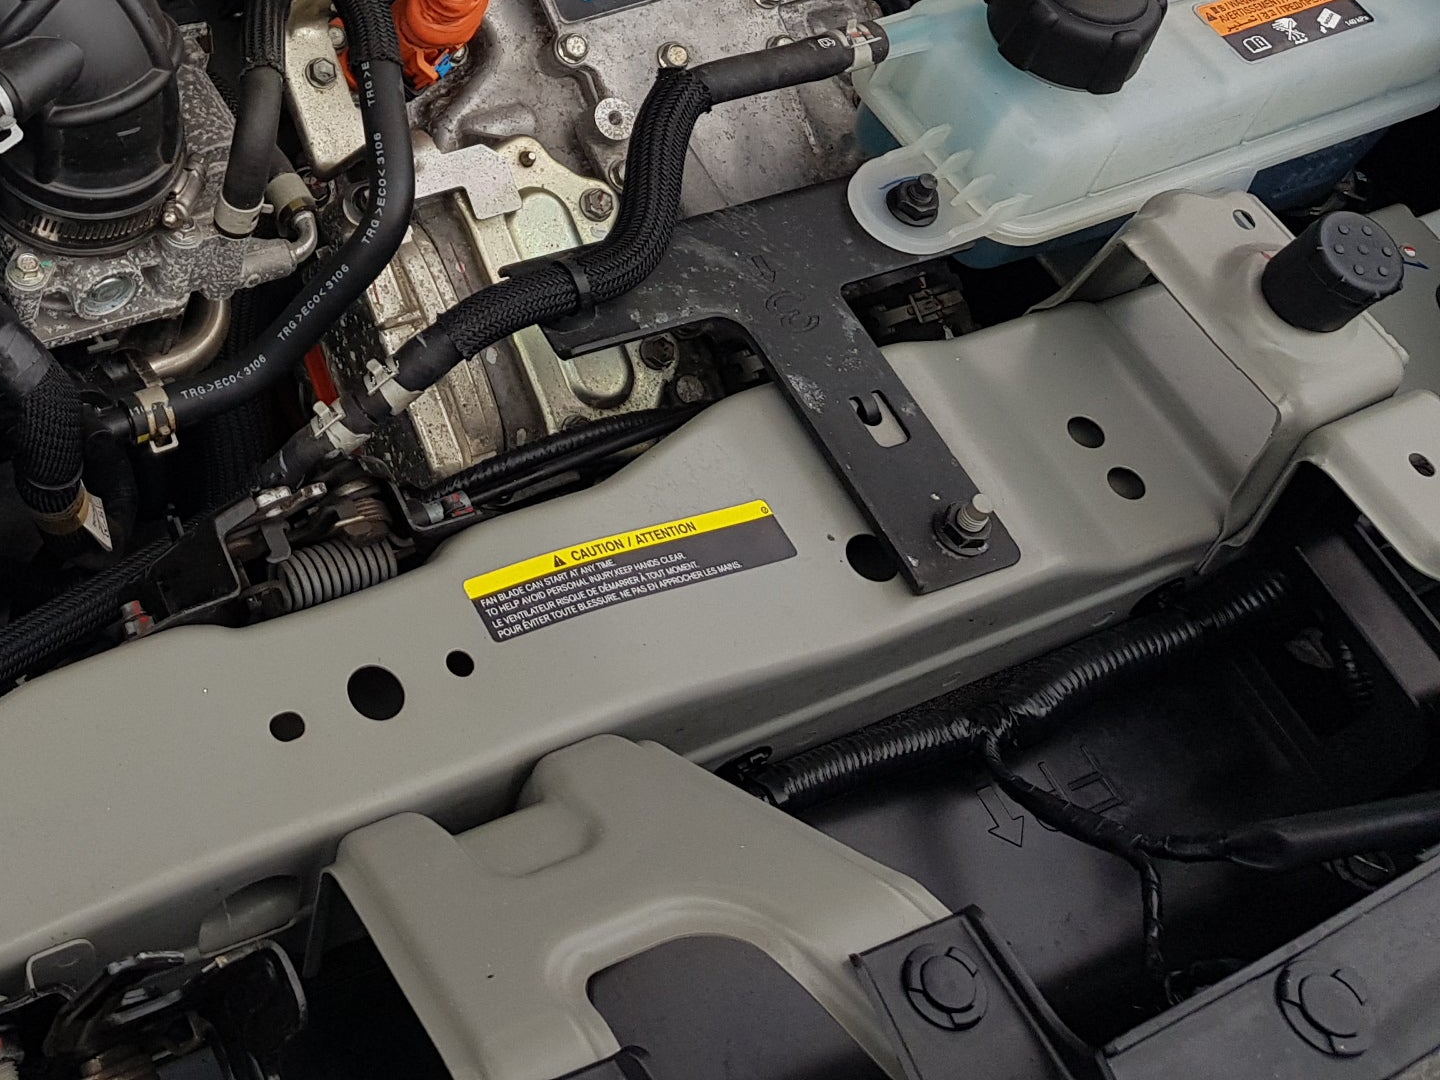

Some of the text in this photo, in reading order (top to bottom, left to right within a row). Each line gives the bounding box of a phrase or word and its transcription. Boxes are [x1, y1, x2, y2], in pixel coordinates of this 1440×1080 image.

[570, 538, 625, 561] CAUTION
[635, 521, 697, 545] ATTENTION
[480, 559, 616, 608] FAN BLADE CAN START AT ANY TIME.
[485, 606, 499, 618] TO
[499, 599, 520, 613] HELP
[522, 592, 546, 606] AVOID
[546, 578, 589, 597] PERSONAL
[634, 558, 660, 571] HANDS
[660, 552, 686, 565] CLEAR.
[491, 561, 699, 629] LE VENTILATEUR RISQUE DE DÉMARRER À TOUT MOMENT.
[497, 626, 523, 639] POUR
[522, 615, 551, 630] ÉVITER
[550, 605, 577, 619] TOUTE
[620, 588, 632, 599] NE
[631, 585, 647, 596] PAS
[647, 581, 659, 591] EN
[659, 571, 706, 589] APPROCHER
[705, 566, 718, 577] LES
[717, 561, 743, 574] MAINS.
